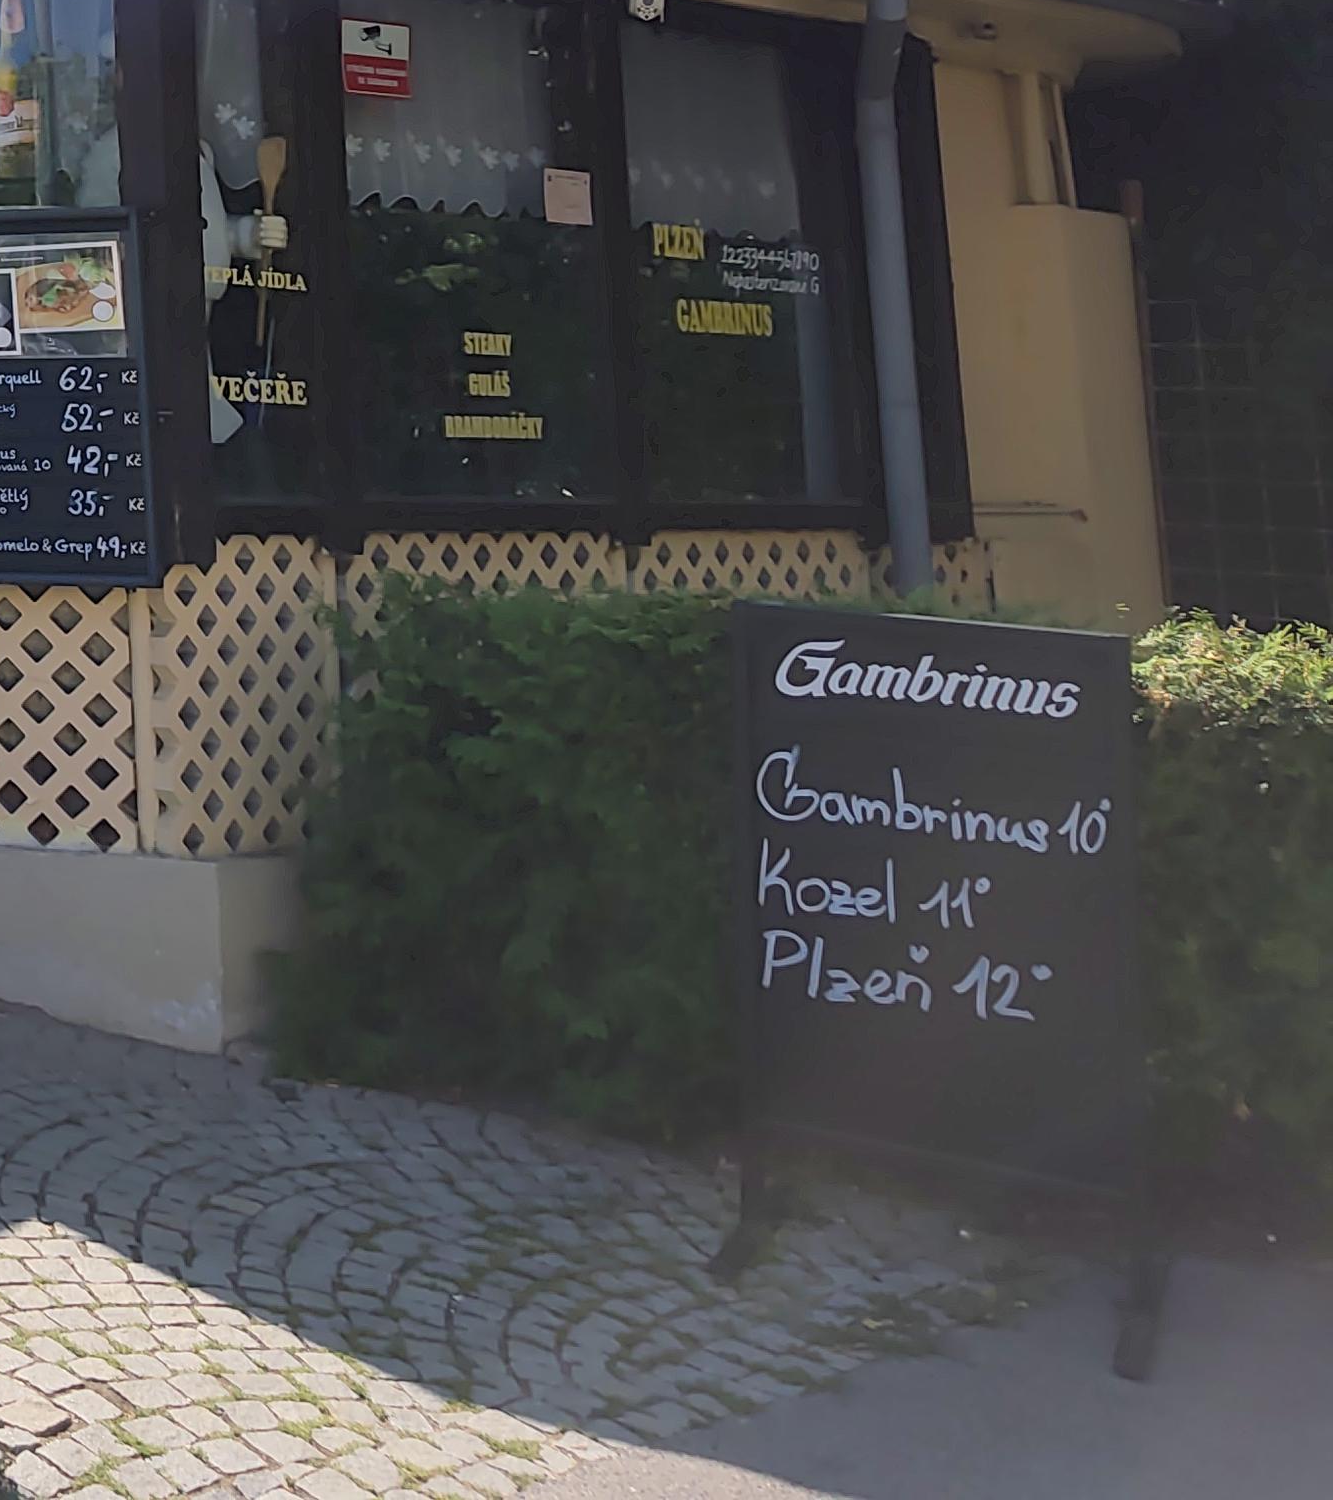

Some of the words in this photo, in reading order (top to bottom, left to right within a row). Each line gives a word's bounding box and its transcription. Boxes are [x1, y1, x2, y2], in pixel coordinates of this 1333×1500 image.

[258, 266, 307, 291] JÍDLA
[121, 370, 139, 384] Kč
[211, 371, 308, 406] VEČEŘE
[123, 411, 140, 425] Kč
[34, 459, 52, 472] 10
[126, 454, 143, 468] Kč
[128, 498, 145, 512] Kč
[42, 538, 53, 551] &
[54, 538, 93, 561] Grep
[129, 541, 146, 555] Kč
[774, 639, 1081, 718] Gambrinus
[756, 743, 1049, 853] Gambrinus
[758, 837, 898, 924] Kozel
[761, 929, 933, 1012] Plzeň
